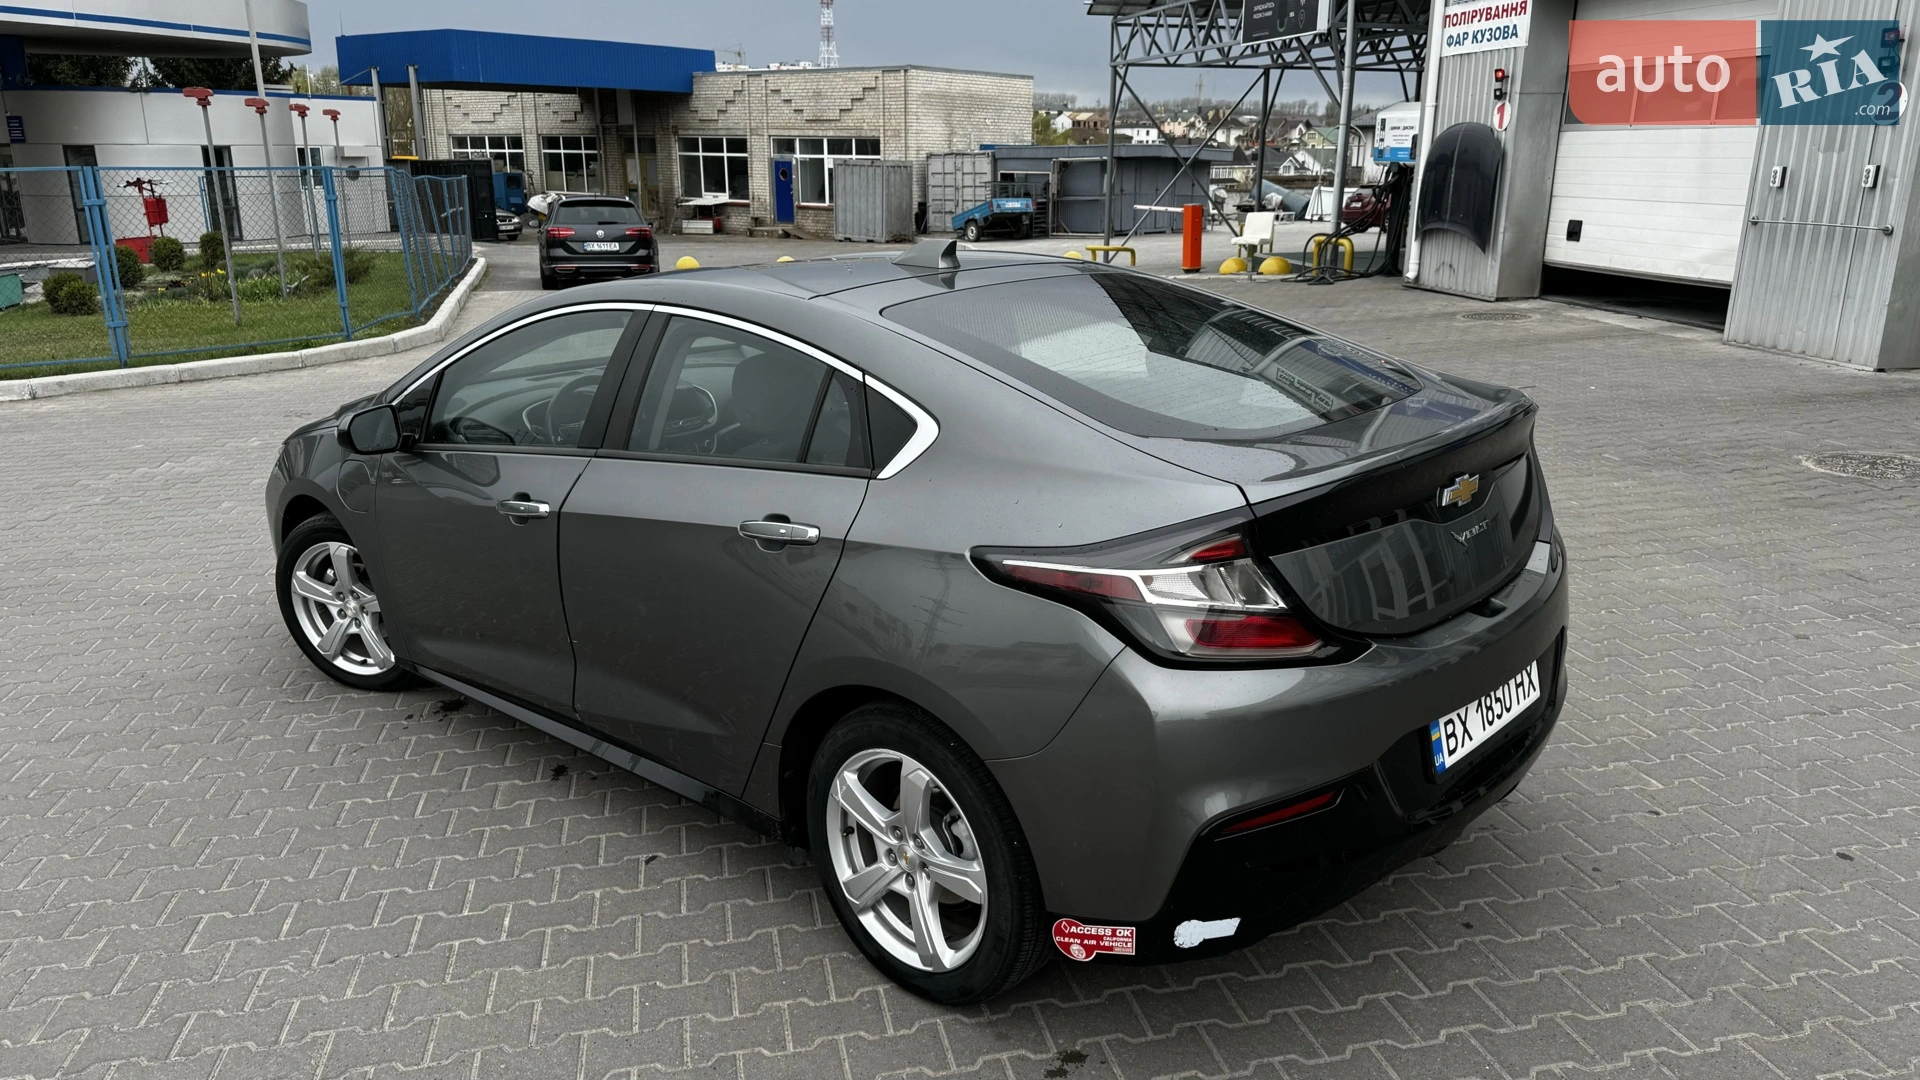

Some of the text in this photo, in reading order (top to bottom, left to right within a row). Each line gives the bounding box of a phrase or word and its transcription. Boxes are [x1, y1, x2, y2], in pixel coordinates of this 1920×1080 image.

[1443, 0, 1528, 28] ПОЛІРУВАННЯ
[1446, 24, 1519, 48] ФАР КУЗОВА
[1496, 101, 1506, 130] 1
[1450, 519, 1489, 546] VOLT
[1443, 664, 1537, 758] BX 1850 HX
[1434, 752, 1445, 767] UA
[1055, 936, 1133, 948] CLEAN AIR VEHICLE
[1069, 925, 1132, 937] ACCESS OK
